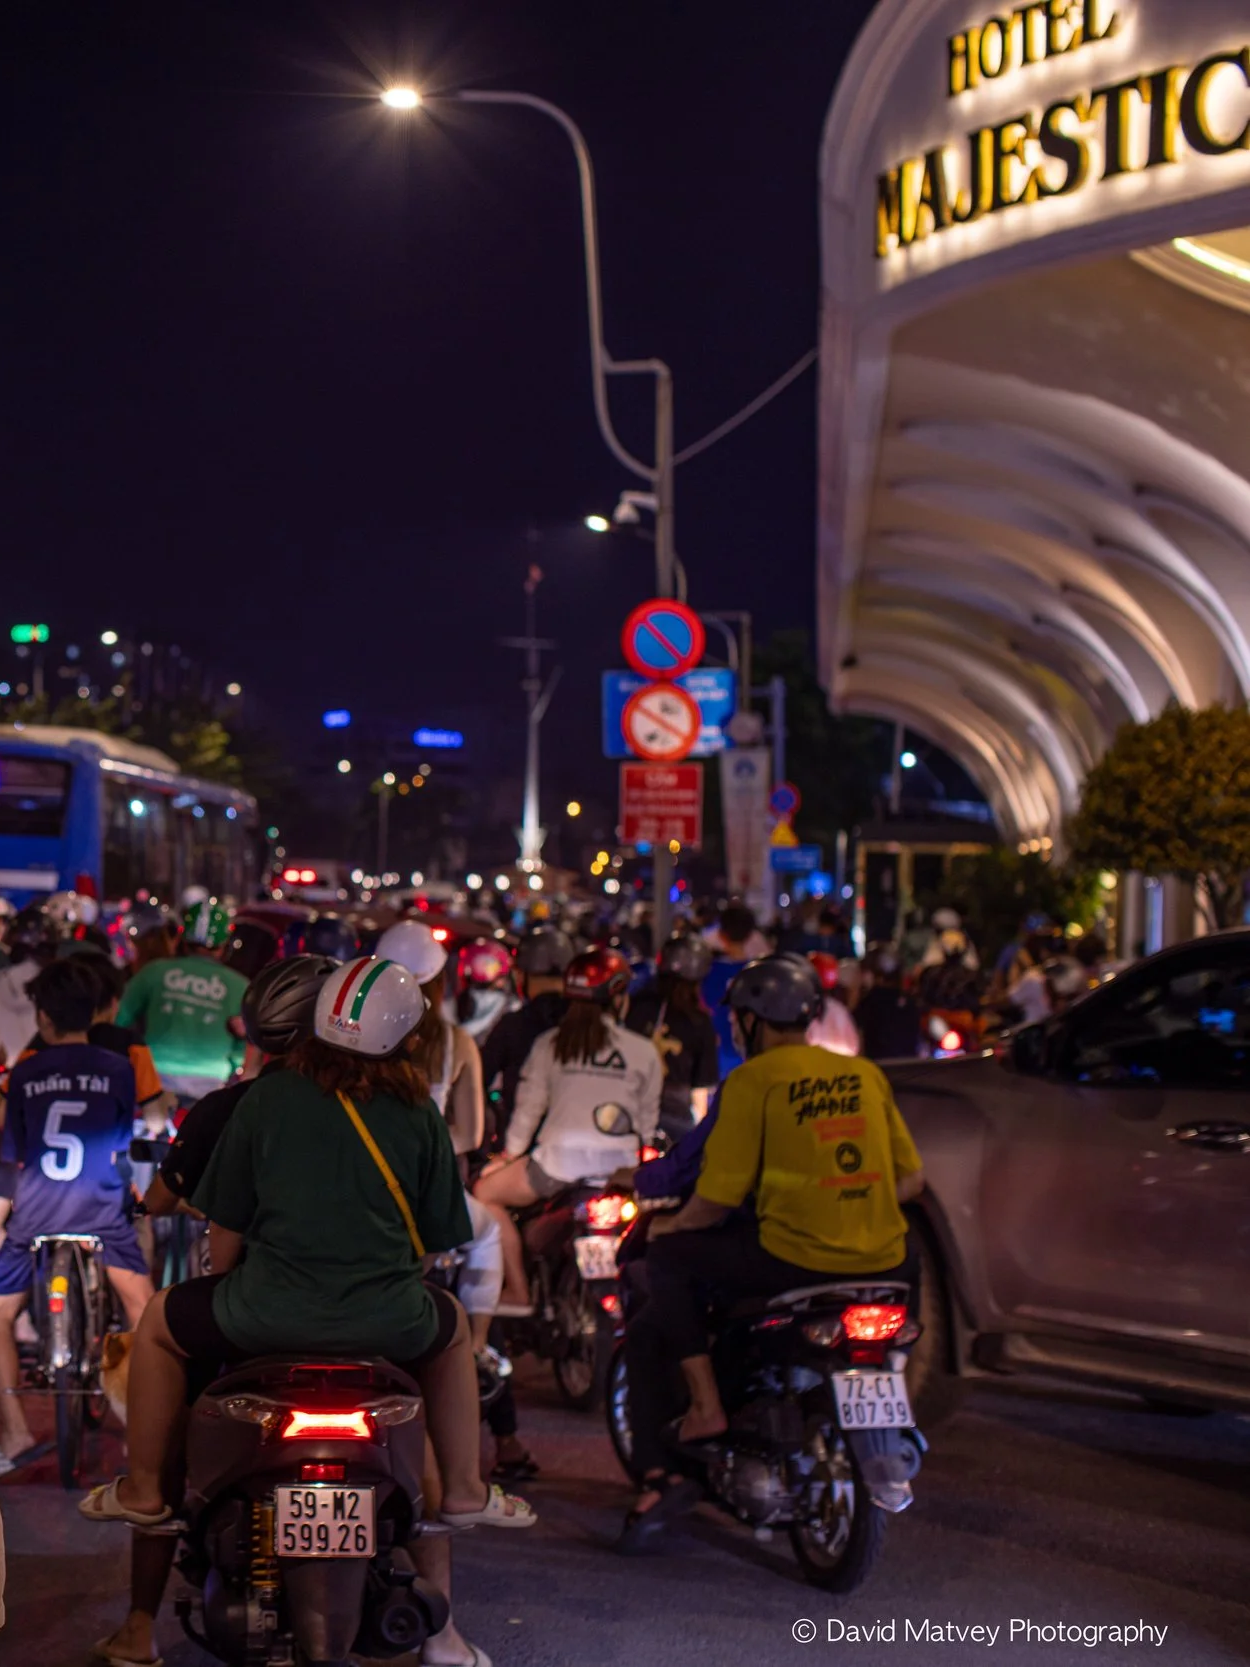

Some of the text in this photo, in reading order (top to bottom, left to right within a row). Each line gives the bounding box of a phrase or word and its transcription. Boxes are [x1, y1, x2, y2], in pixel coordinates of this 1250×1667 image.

[947, 0, 1121, 98] HOTEL
[875, 45, 1250, 260] MAJESTIC
[163, 967, 228, 1001] Grab
[40, 1100, 87, 1182] 5
[290, 1491, 361, 1520] 59-M2
[283, 1523, 368, 1553] 599.26
